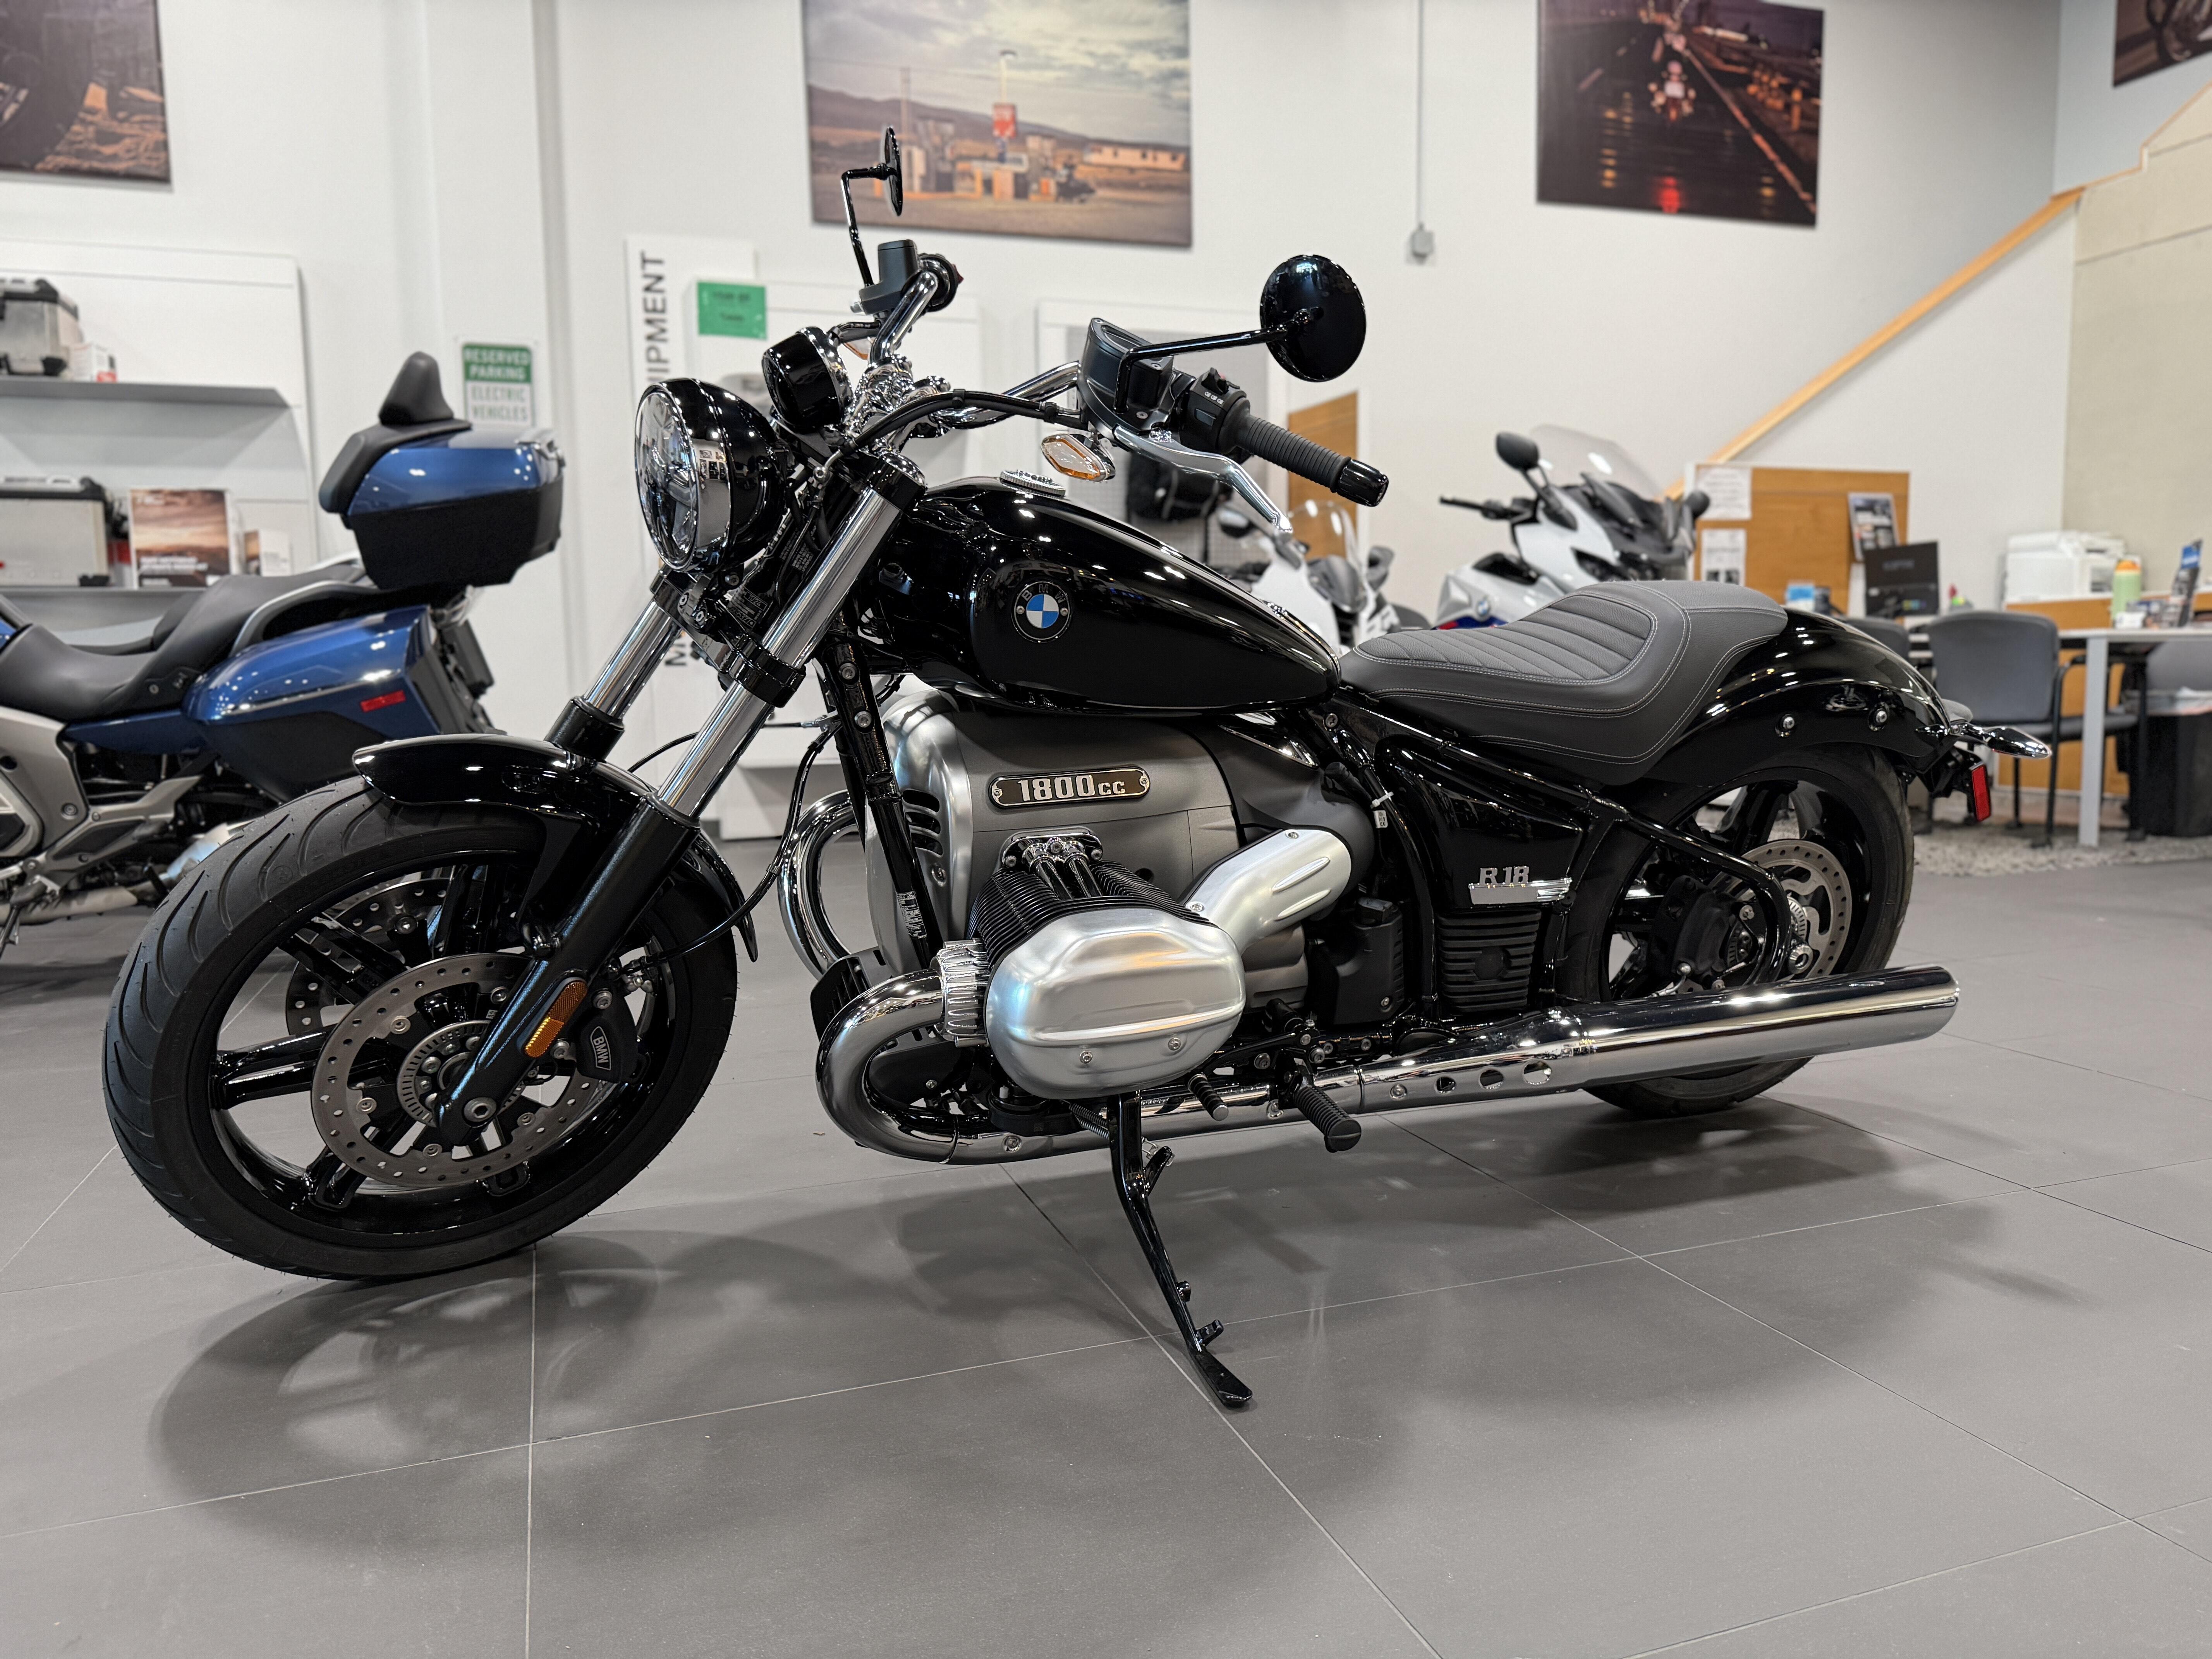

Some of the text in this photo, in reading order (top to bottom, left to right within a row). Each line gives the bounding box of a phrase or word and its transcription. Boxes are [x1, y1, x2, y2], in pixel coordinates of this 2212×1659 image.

[641, 251, 671, 384] IPMENT
[464, 348, 529, 365] RESERVED
[470, 366, 526, 380] PARKING
[471, 386, 525, 402] ELECTRIC
[471, 405, 527, 421] VEHICLES
[1021, 583, 1066, 603] BMW
[1479, 866, 1530, 884] R 18
[593, 1036, 610, 1064] BMW
